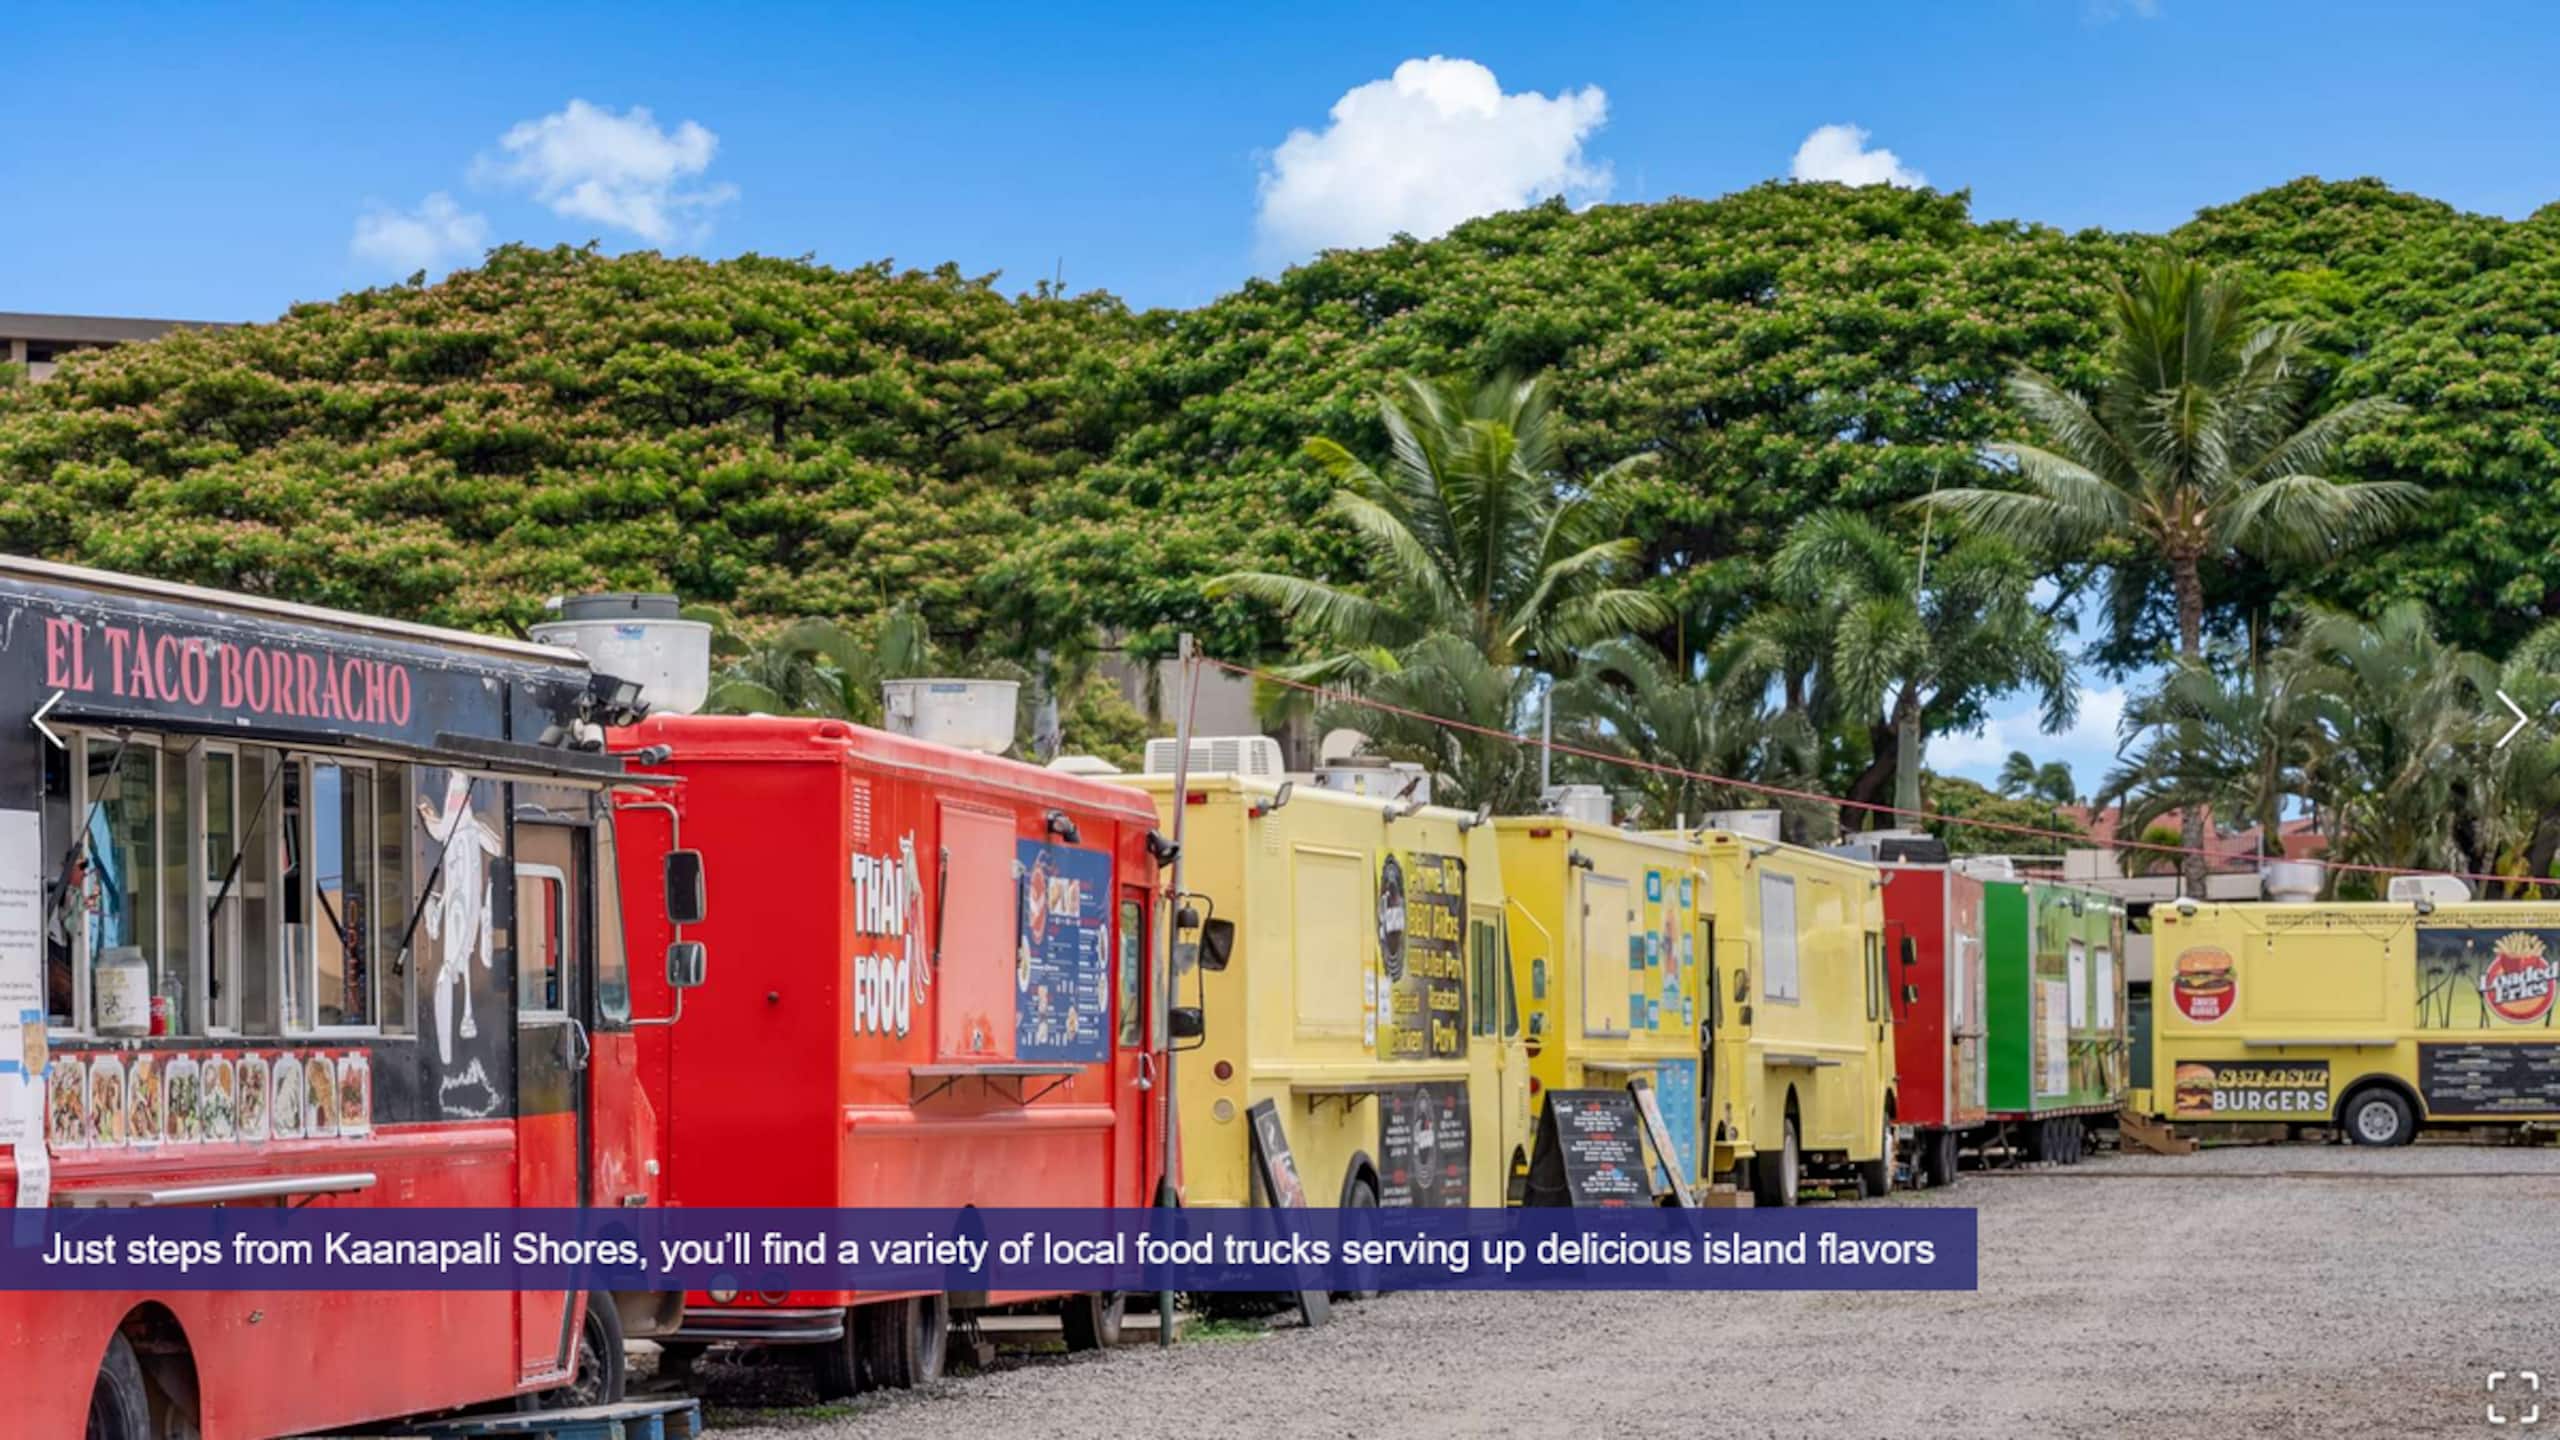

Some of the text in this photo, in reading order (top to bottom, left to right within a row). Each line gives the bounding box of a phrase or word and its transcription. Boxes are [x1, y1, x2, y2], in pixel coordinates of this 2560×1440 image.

[45, 618, 411, 726] EL TACO BORRACHO
[852, 852, 904, 936] THAI
[1433, 905, 1459, 942] Ribs
[2480, 961, 2558, 991] Loaded
[2496, 978, 2548, 1003] Fries
[2212, 1090, 2328, 1111] BURGERS
